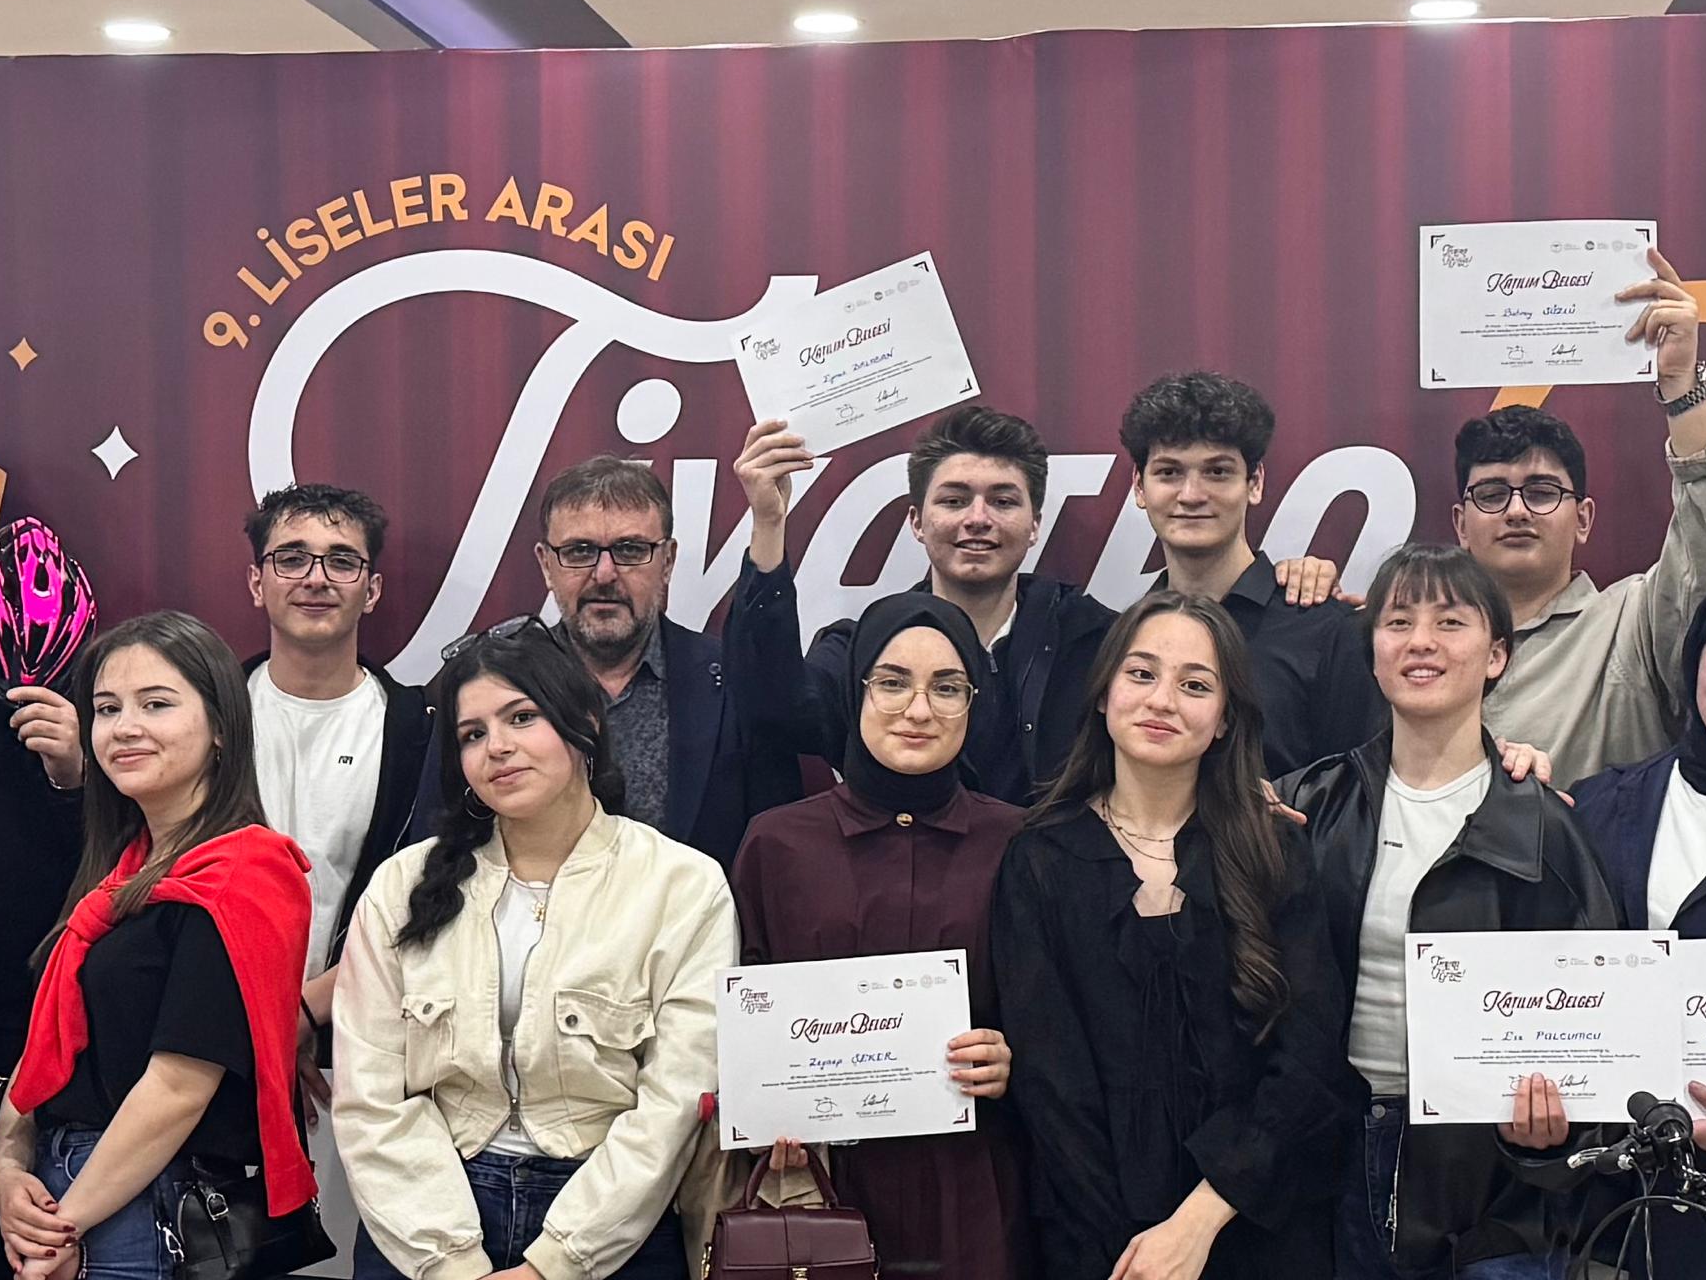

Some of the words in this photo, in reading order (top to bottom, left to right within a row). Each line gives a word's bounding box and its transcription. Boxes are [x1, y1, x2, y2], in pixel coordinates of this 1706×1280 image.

[203, 311, 261, 349] 9.
[237, 173, 468, 305] LİSELER
[485, 175, 675, 281] ARASI
[1487, 272, 1541, 296] KATILIM
[1542, 269, 1594, 290] BELGESİ
[1483, 990, 1543, 1017] KATILIM
[1546, 988, 1605, 1010] BELGESİ
[790, 1018, 848, 1043] KATILIM
[850, 1012, 904, 1034] BELGESİ
